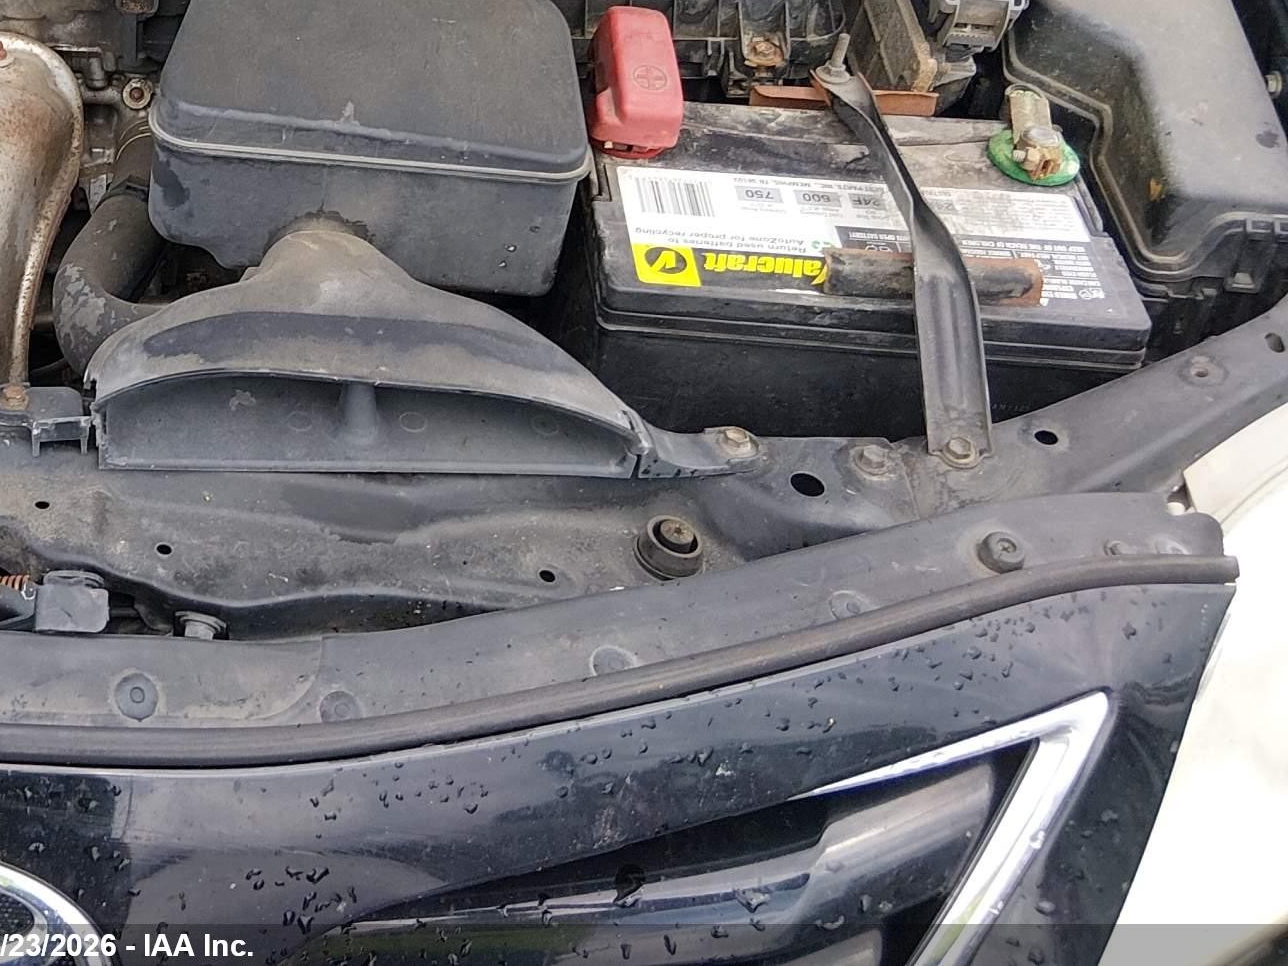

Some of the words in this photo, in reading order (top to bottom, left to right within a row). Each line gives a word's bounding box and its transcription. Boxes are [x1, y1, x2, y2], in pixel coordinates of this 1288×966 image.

[744, 189, 775, 200] 750
[634, 227, 686, 237] recycling
[689, 232, 727, 242] proper
[682, 238, 734, 248] batteries
[730, 235, 748, 243] for
[753, 236, 805, 245] AutoZone
[736, 241, 765, 249] used
[768, 243, 807, 253] Return
